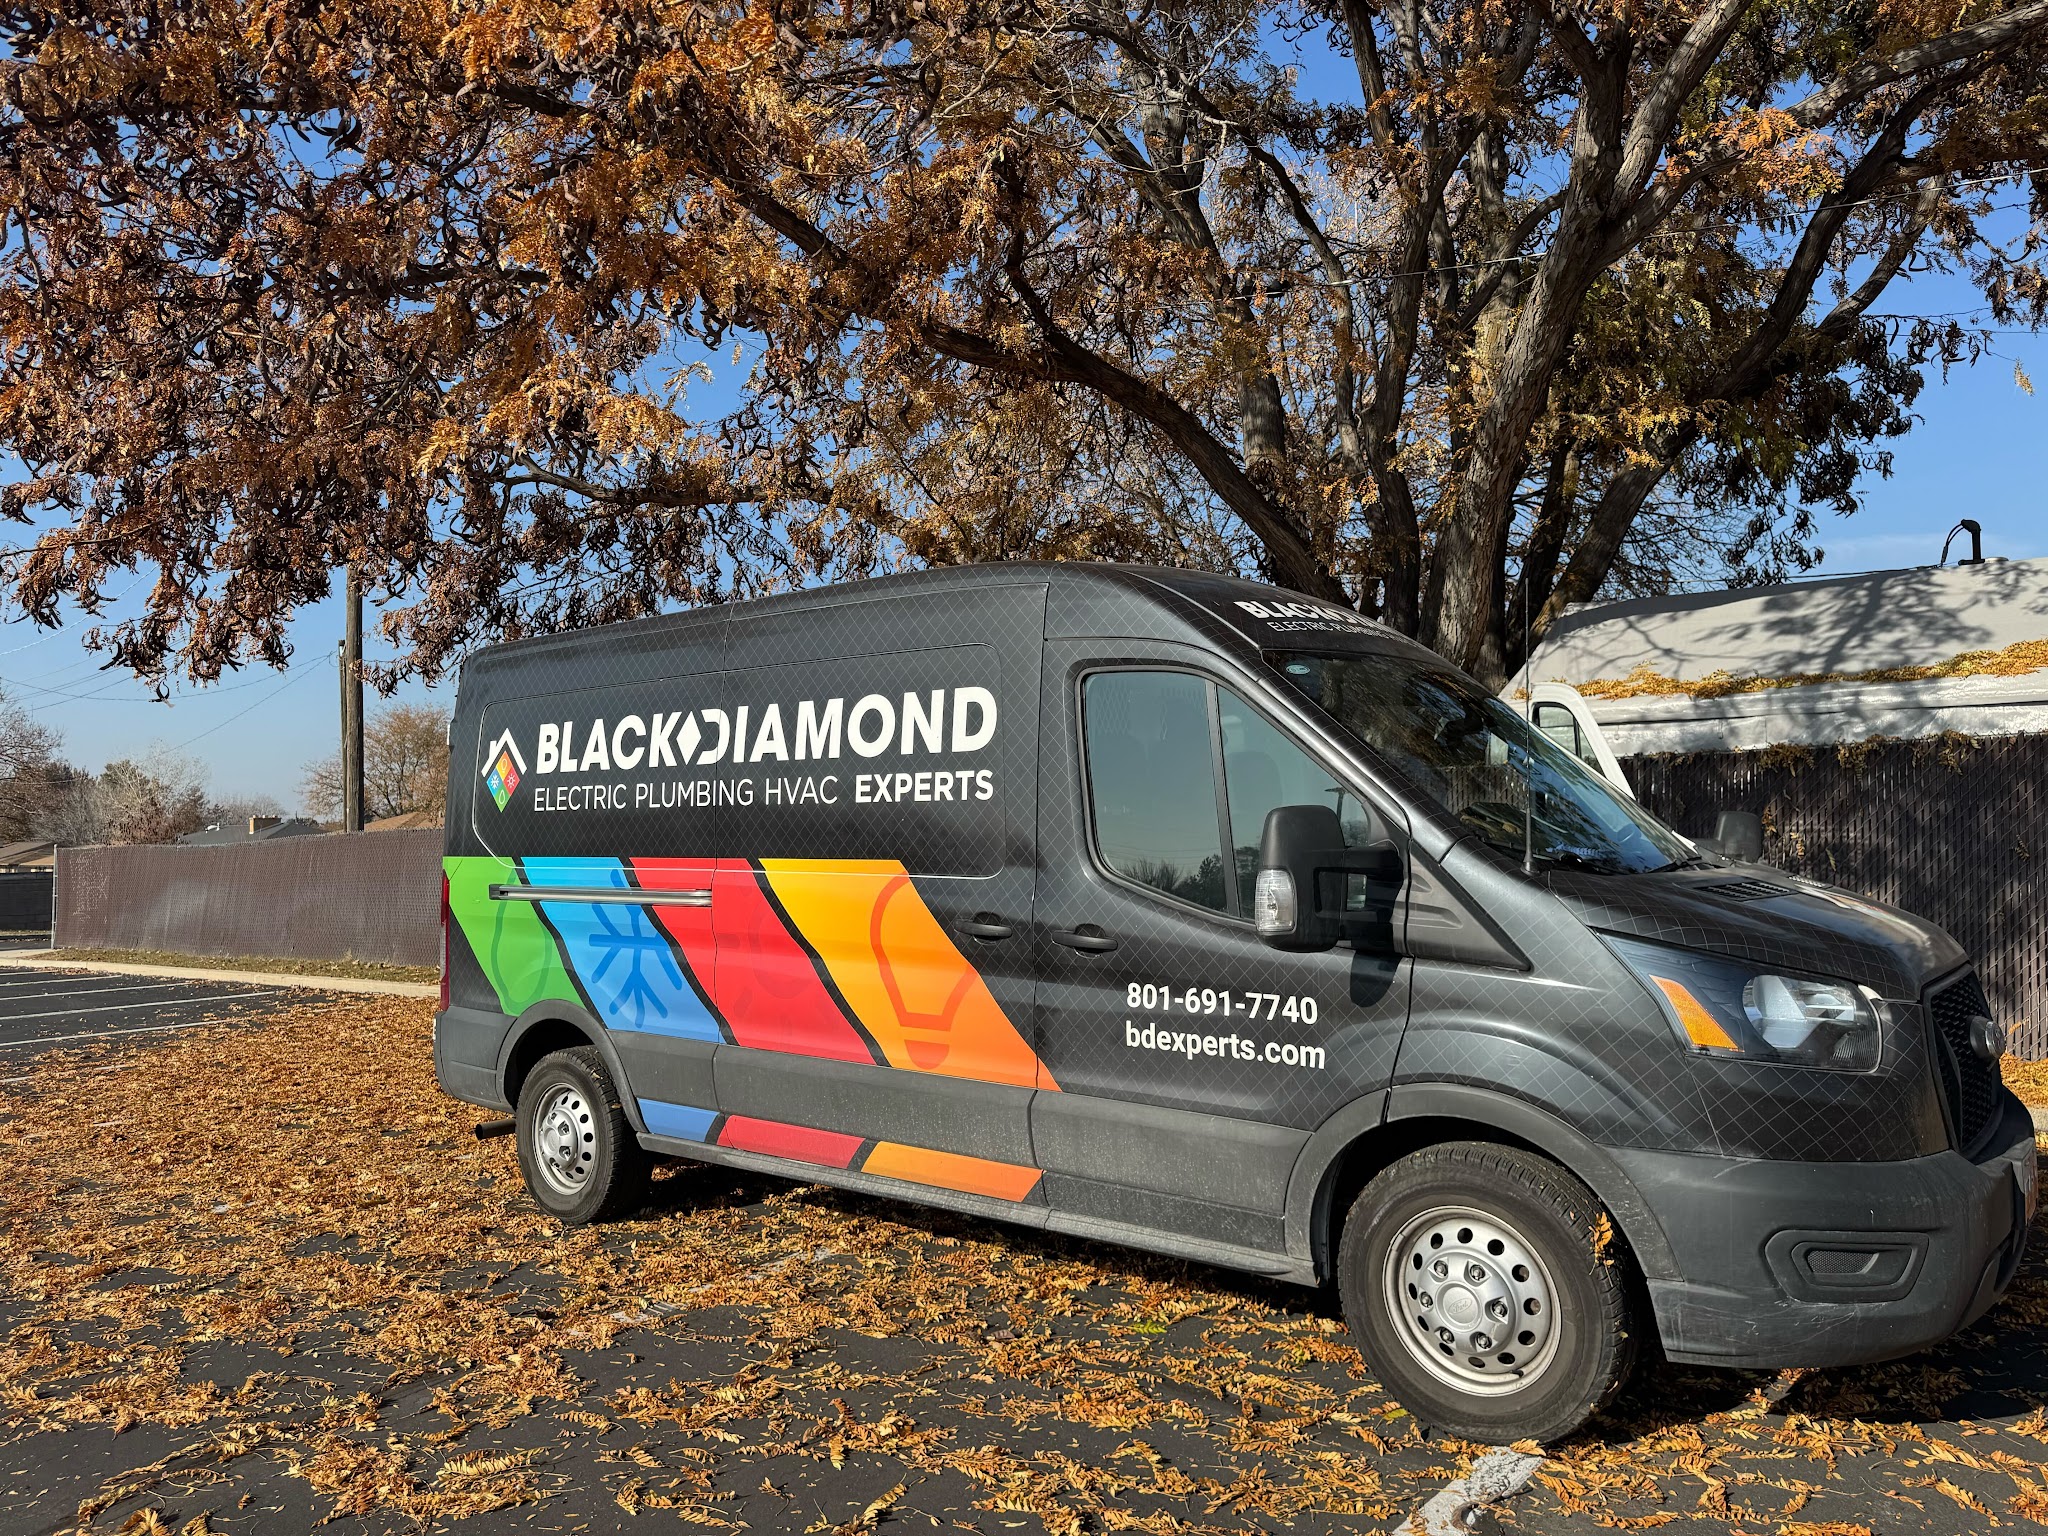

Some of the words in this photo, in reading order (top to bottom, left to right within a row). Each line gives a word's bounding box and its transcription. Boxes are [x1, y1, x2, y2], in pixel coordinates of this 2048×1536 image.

[1233, 600, 1338, 621] BLACK
[1266, 621, 1334, 632] ELECTRIC
[533, 783, 627, 811] ELECTRIC
[635, 778, 754, 808] PLUMBING
[765, 775, 838, 805] HVAC
[855, 769, 994, 803] EXPERTS
[1126, 982, 1318, 1025] 801-691-7740
[1125, 1020, 1326, 1070] bdexperts.com
